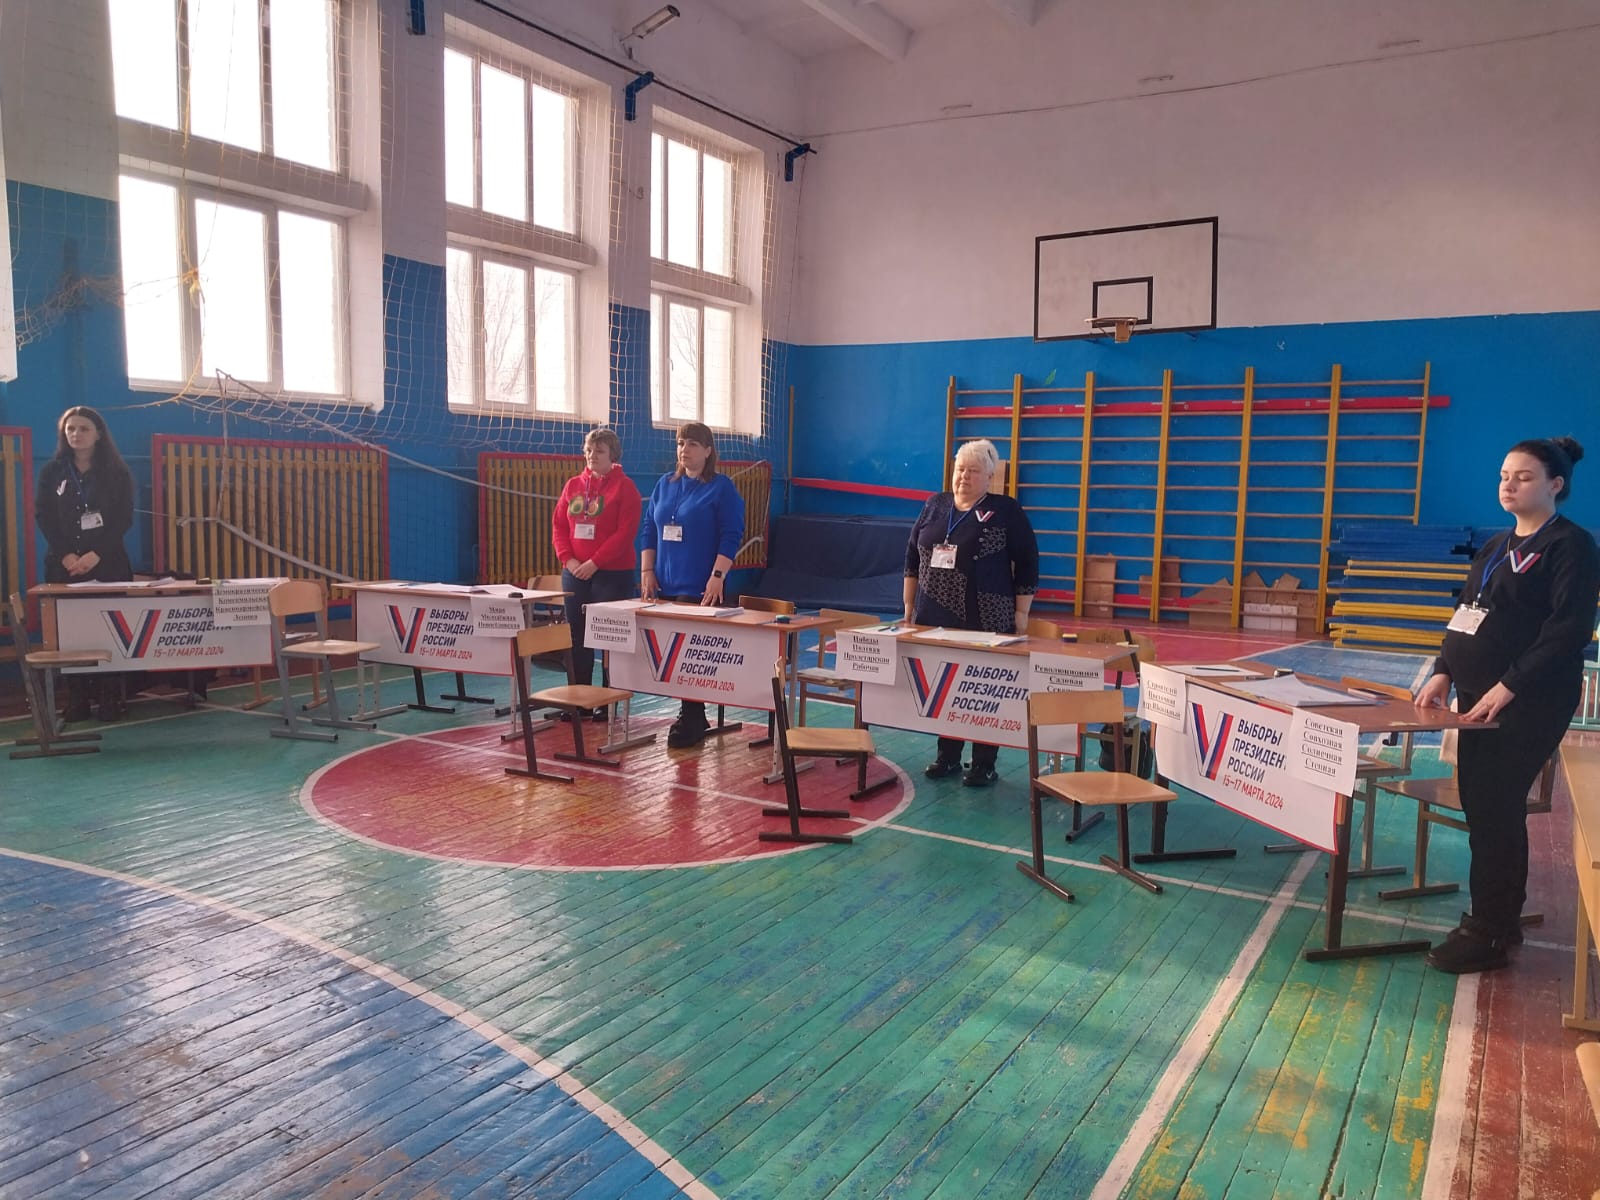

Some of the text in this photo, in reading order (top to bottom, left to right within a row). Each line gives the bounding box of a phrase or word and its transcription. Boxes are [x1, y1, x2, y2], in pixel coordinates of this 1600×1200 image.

[430, 608, 470, 621] ВЫБОРЫ
[592, 615, 629, 627] Октябрьская
[162, 621, 232, 633] ПРЕЗИДЕ
[425, 621, 474, 635] ПРЕЗИДЕНТ
[157, 634, 204, 647] РОССИИ
[422, 635, 457, 647] РОССИИ
[690, 634, 733, 648] ВЫБОРЫ
[176, 647, 204, 657] МАРТА
[205, 646, 225, 656] 2024
[436, 648, 457, 658] МАРТА
[457, 650, 473, 660] 2024
[684, 648, 745, 666] ПРЕЗИДЕНТА
[679, 662, 718, 677] РОССИИ
[964, 665, 1020, 682] ВЫБОРЫ
[695, 678, 718, 690] МАРТА
[718, 680, 735, 692] 2024
[1048, 676, 1084, 687] Садовая
[958, 681, 1030, 700] ПРЕЗИДЕНТ
[952, 696, 1000, 714] РОССИИ
[971, 714, 1000, 729] МАРТА
[1000, 719, 1022, 732] 2024
[1304, 717, 1344, 737] Советская
[1237, 718, 1284, 746] ВЫБОРЫ
[1303, 730, 1343, 751] Совхозная
[1232, 737, 1287, 771] ПРЕЗИДЕН
[1300, 743, 1343, 765] Солнечная
[1227, 756, 1266, 784] РОССИИ
[1304, 757, 1336, 777] Степная
[1242, 781, 1265, 804] МАРТА
[1264, 792, 1284, 810] 2024
